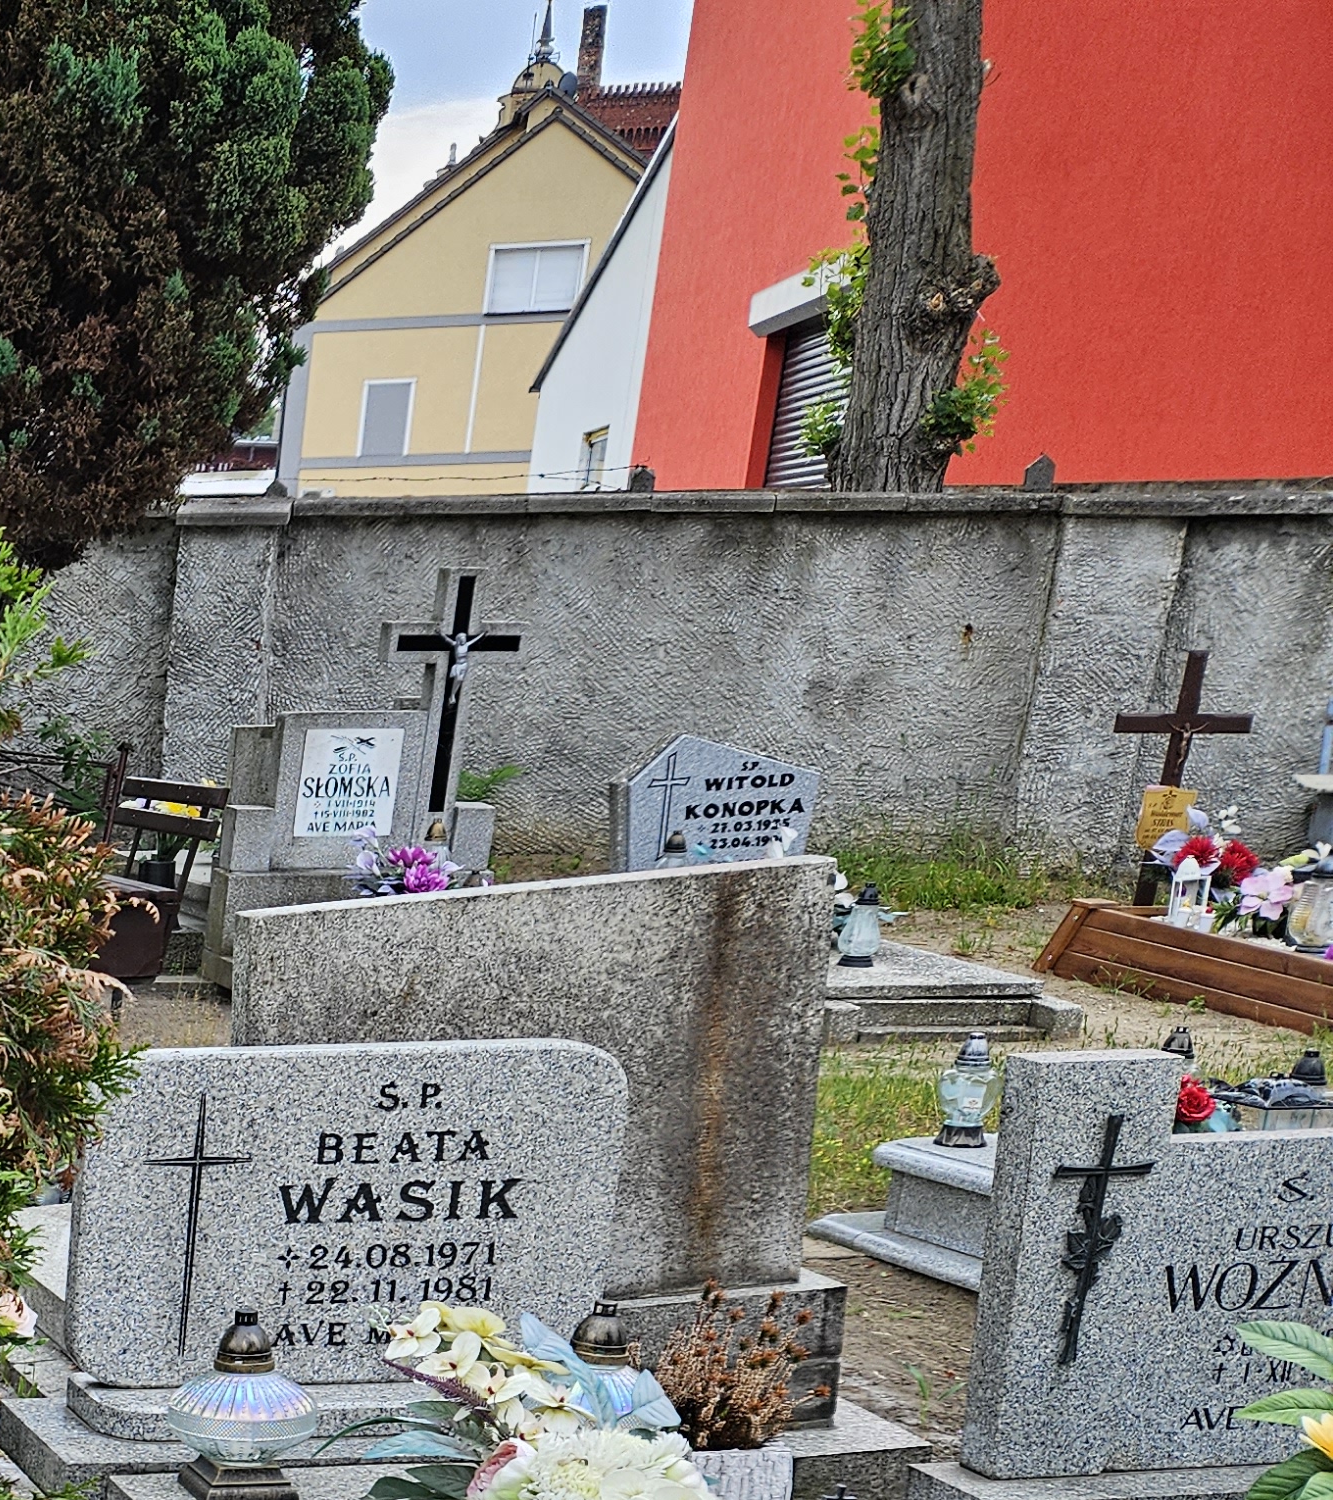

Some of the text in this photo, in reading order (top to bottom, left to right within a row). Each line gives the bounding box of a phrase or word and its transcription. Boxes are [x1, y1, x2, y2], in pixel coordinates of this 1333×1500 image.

[328, 763, 371, 775] ZOFIA
[302, 776, 391, 798] SŁOMSKA
[704, 773, 795, 792] WITOLD
[684, 798, 806, 820] KONOPKA
[307, 821, 330, 833] AVE
[315, 1128, 491, 1165] BEATA
[278, 1177, 523, 1225] WASIK
[307, 1241, 497, 1271] 24.08.1971
[270, 1320, 348, 1348] AVE
[1179, 1405, 1246, 1431] AVE
